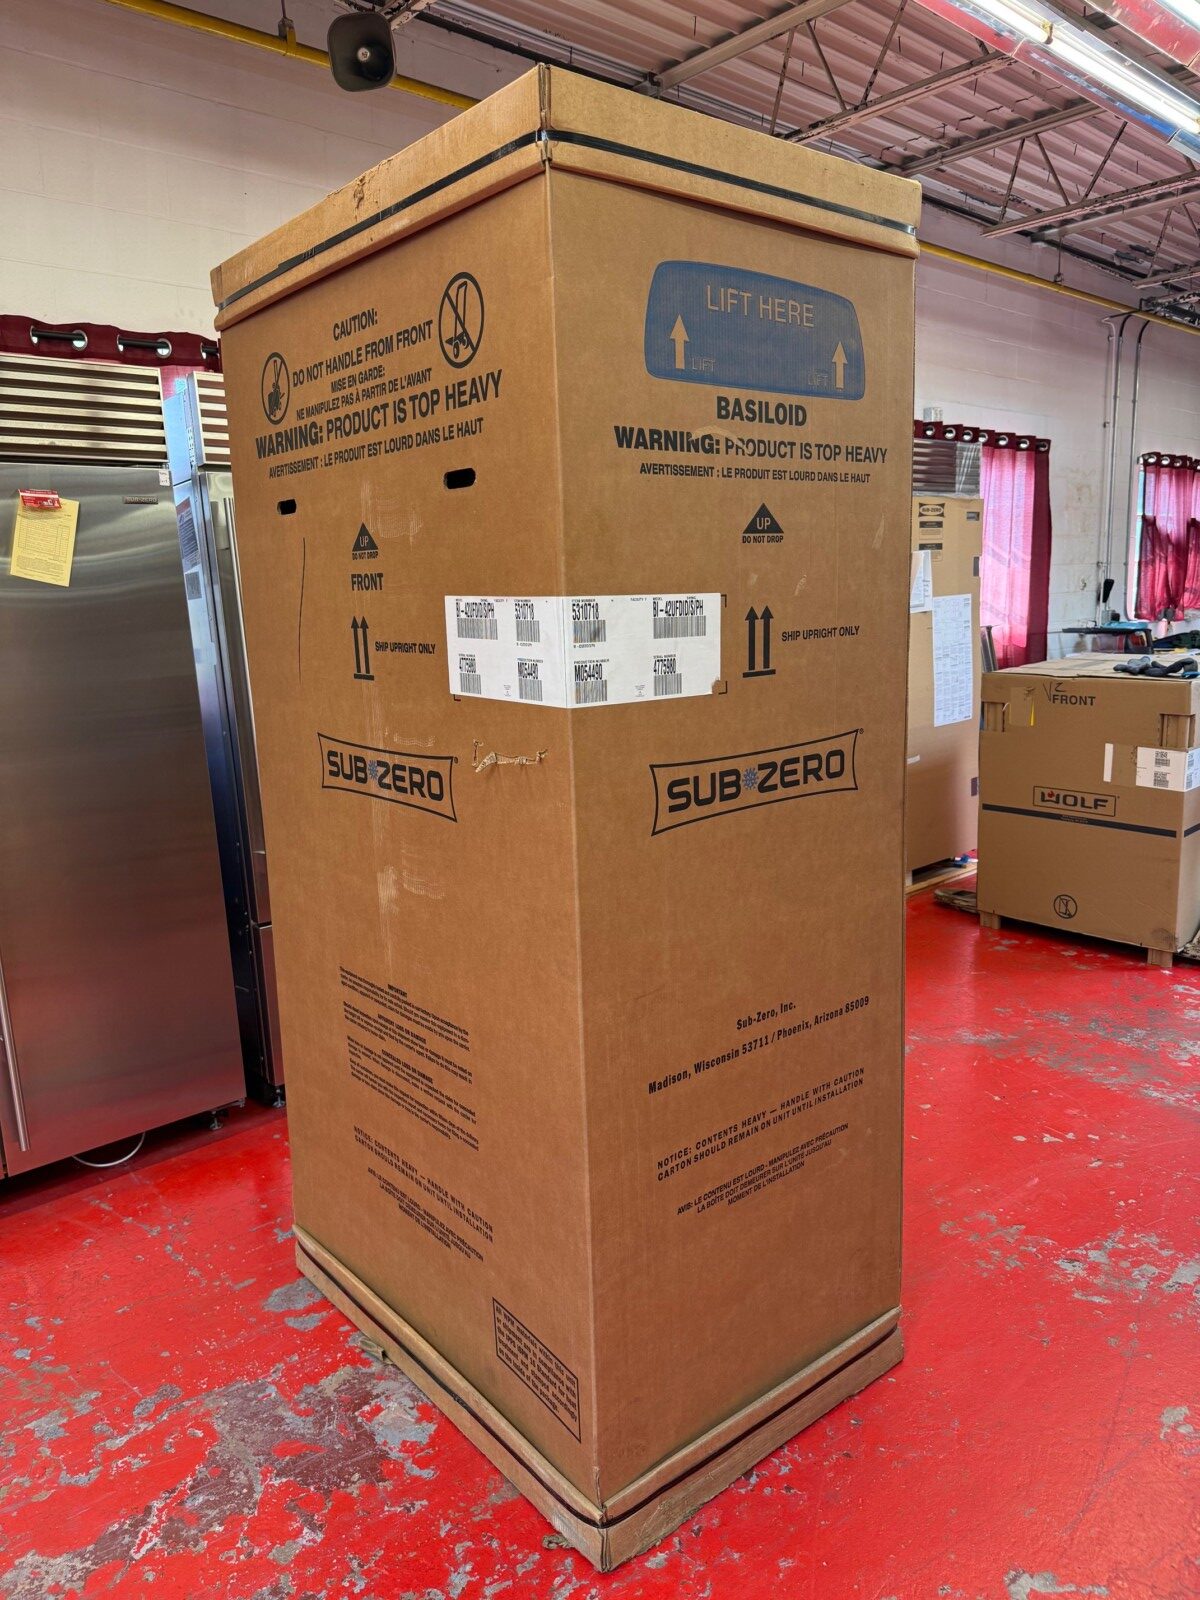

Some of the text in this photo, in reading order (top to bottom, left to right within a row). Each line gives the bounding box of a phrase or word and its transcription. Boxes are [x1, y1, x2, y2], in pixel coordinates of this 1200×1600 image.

[707, 285, 814, 327] LIFT HERE
[333, 308, 378, 341] CAUTION:
[293, 320, 433, 388] DO NOT HANDLE FROM FRONT
[692, 358, 716, 372] LIFT
[331, 365, 385, 394] MISE EN GARDE:
[808, 373, 828, 387] LIFT
[296, 368, 432, 421] NE MANIPULEZ PAS À PARTIR DE L'AVANT
[255, 369, 503, 459] WARNING: PRODUCT IS TOP HEAVY
[716, 396, 807, 426] BASILOID
[324, 454, 332, 467] LE
[334, 445, 365, 464] PRODUIT
[368, 441, 382, 457] EST
[385, 434, 413, 453] LOURD
[416, 429, 441, 447] DANS
[443, 426, 454, 441] LE
[457, 417, 483, 437] HAUT
[614, 426, 887, 463] WARNING: PRODUCT IS TOP HEAVY
[722, 467, 732, 478] LE
[734, 468, 770, 480] PRODUIT
[773, 469, 787, 480] EST
[789, 470, 816, 482] LOURD
[818, 471, 838, 482] DANS
[840, 472, 849, 482] LE
[851, 472, 870, 483] HAUT
[757, 518, 771, 530] UP
[360, 536, 369, 547] UP
[753, 535, 766, 543] NOT
[767, 535, 783, 543] DROP
[352, 551, 378, 560] DO NOT DROP
[351, 573, 383, 591] FRONT
[572, 603, 599, 621] 5310718
[782, 626, 860, 642] SHIP UPRIGHT ONLY
[375, 641, 435, 654] SHIP UPRIGHT ONLY
[575, 664, 602, 681] M054490
[1052, 694, 1096, 706] FRONT
[1040, 790, 1109, 810] WOLF
[736, 1001, 796, 1030] Sub-Zero, Inc.
[648, 1069, 691, 1095] Madison,
[694, 1048, 740, 1074] Wisconsin
[742, 1035, 769, 1054] 53711
[777, 1017, 812, 1041] Phoenix,
[814, 1009, 844, 1025] Arizona
[845, 996, 869, 1013] 85009
[657, 1067, 864, 1169] NOTICE: CONTENTS HEAVY HANDLE WITH CAUTION
[658, 1078, 863, 1181] CARTON SHOULD REMAIN ON UNIT UNTIL INSTALLATION
